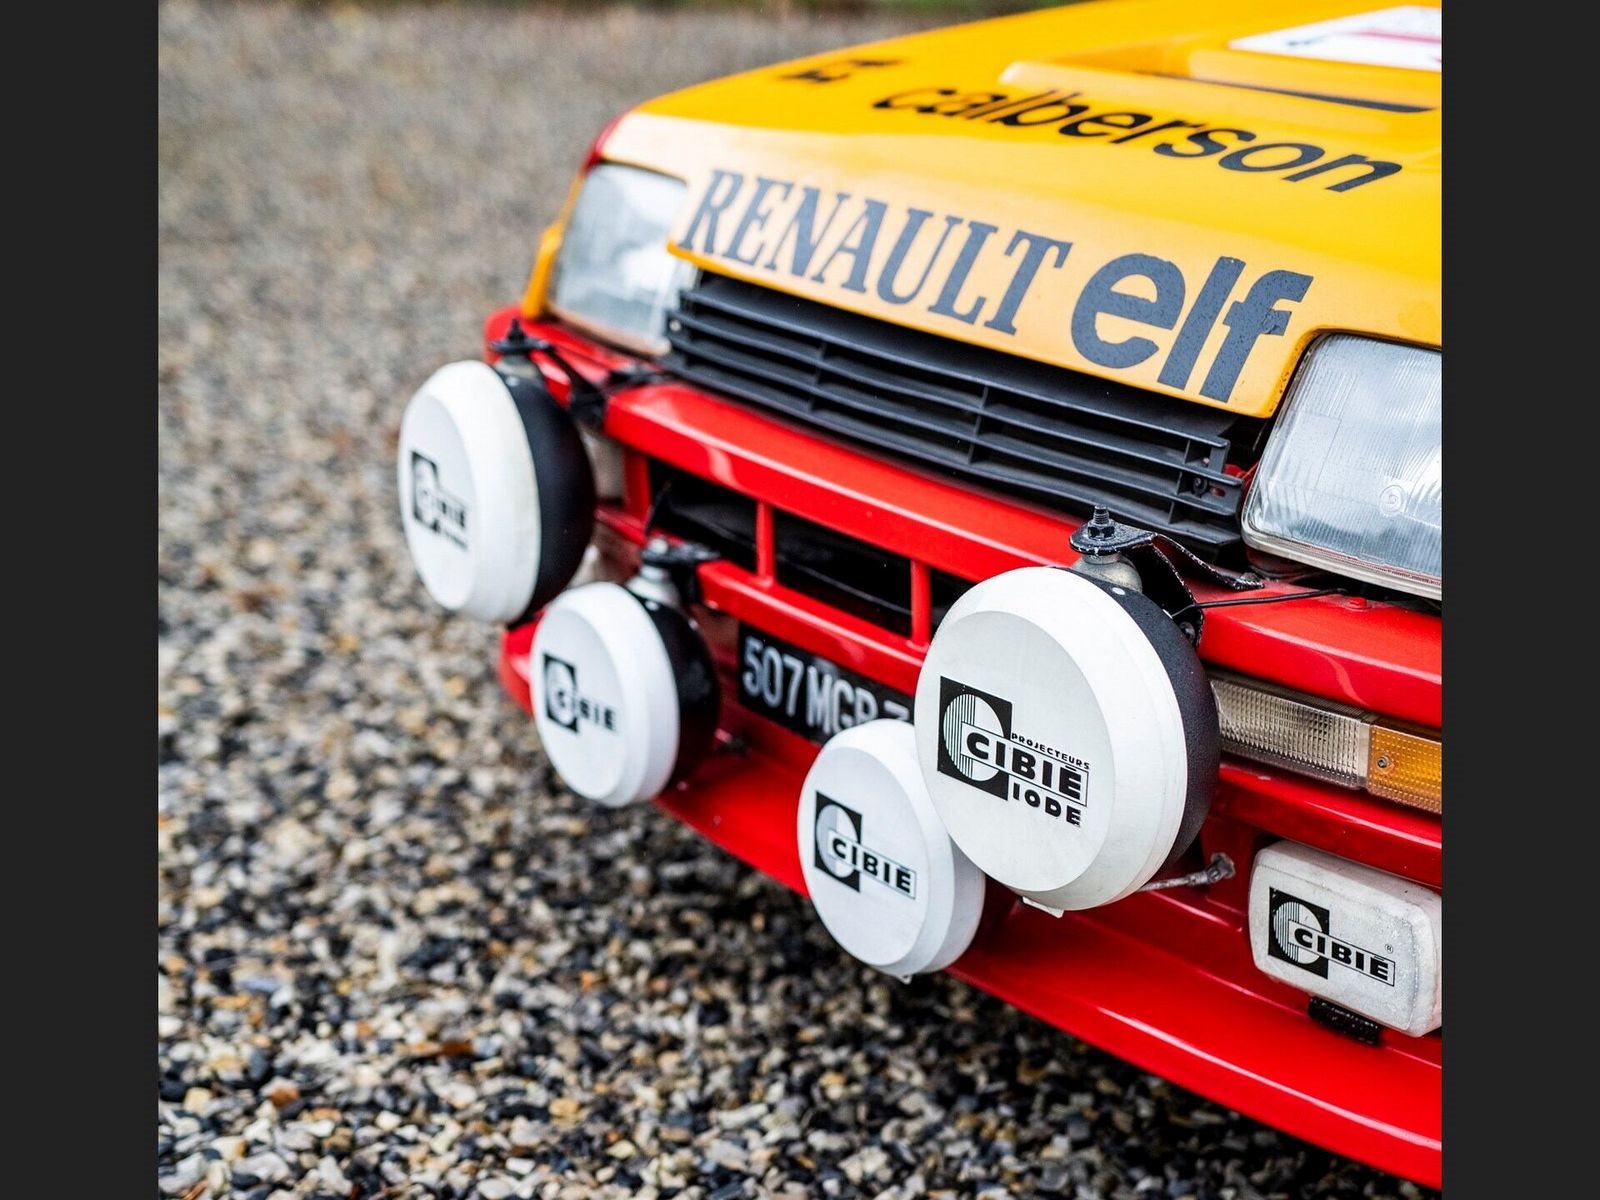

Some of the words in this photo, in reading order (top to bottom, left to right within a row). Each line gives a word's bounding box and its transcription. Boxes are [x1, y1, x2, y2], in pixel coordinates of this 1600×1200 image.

[873, 86, 1402, 193] calberson
[677, 168, 1073, 337] RENAULT
[1070, 252, 1314, 404] elf
[742, 636, 804, 718] 507
[1010, 732, 1091, 770] PROJECTEURS
[1012, 781, 1082, 826] IODE
